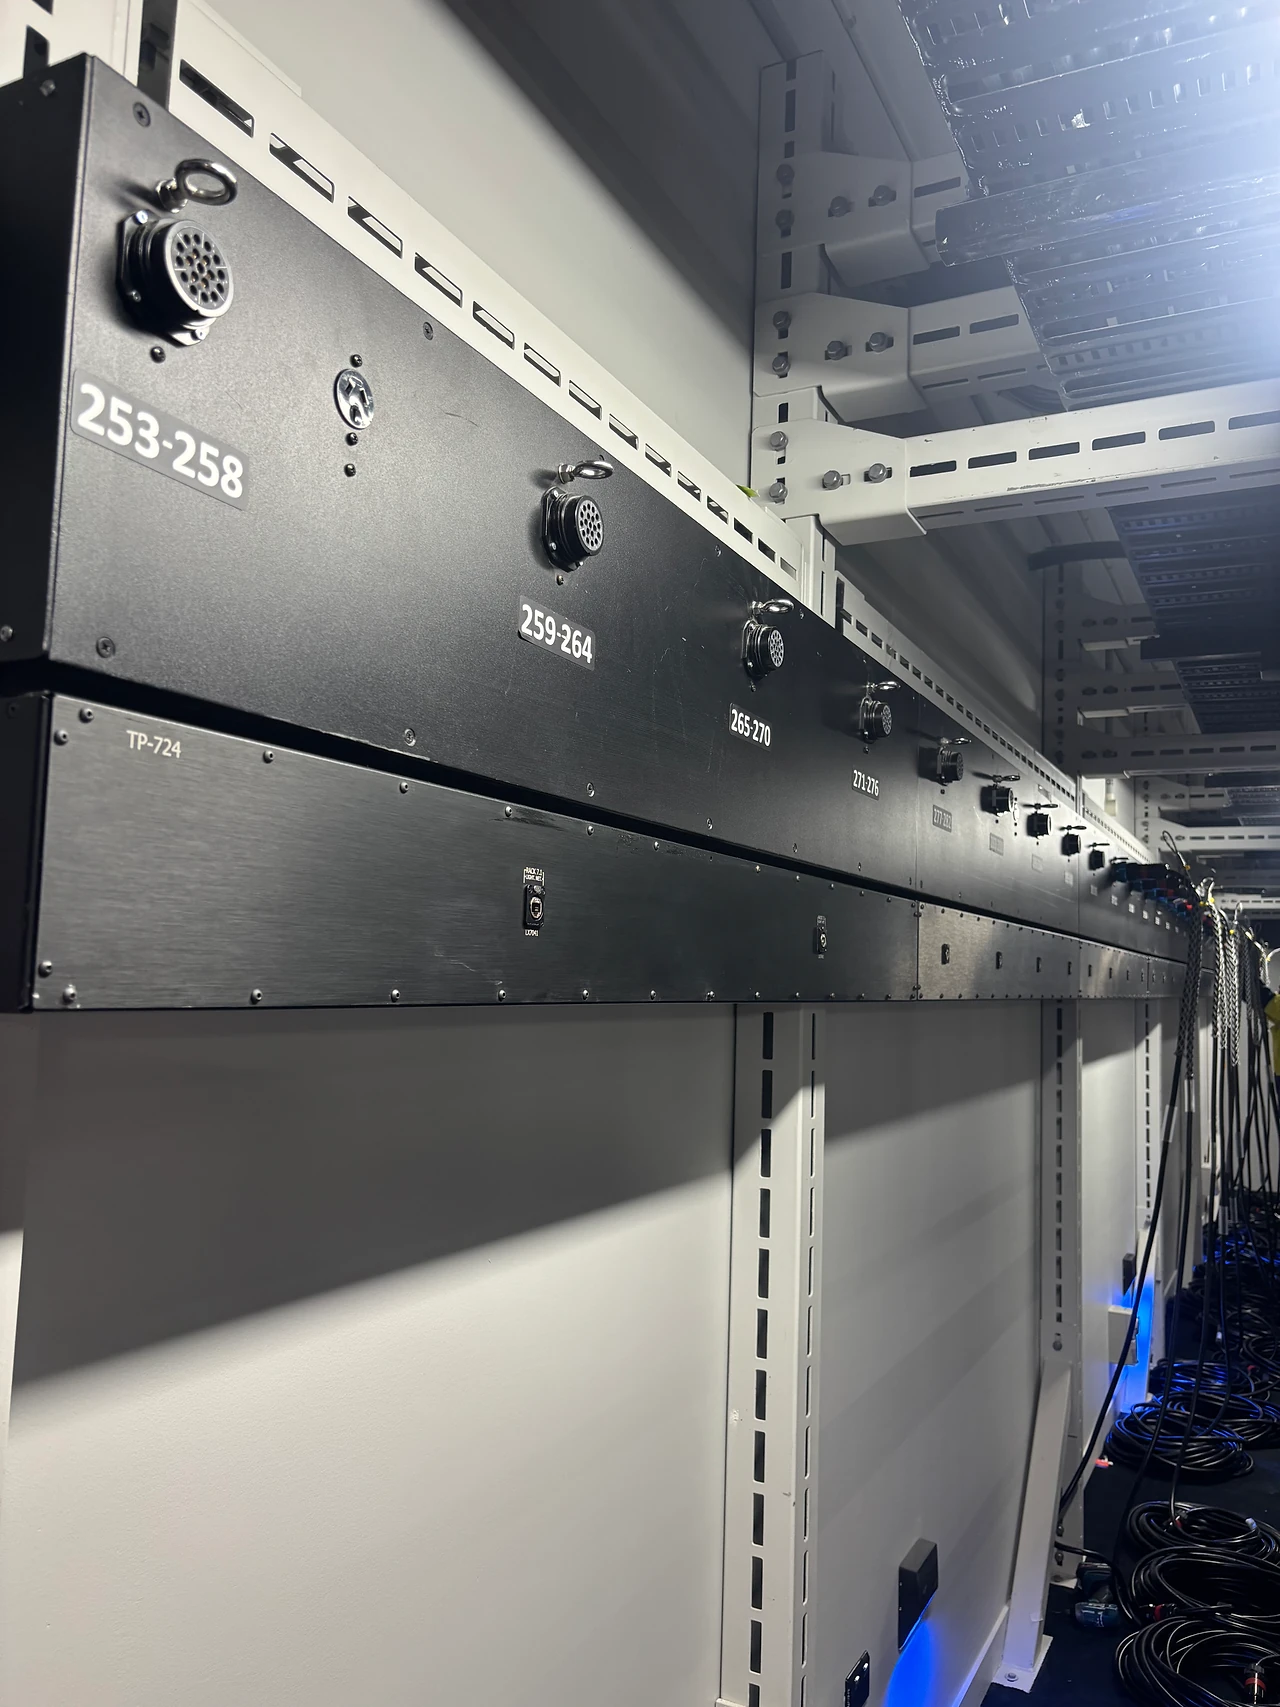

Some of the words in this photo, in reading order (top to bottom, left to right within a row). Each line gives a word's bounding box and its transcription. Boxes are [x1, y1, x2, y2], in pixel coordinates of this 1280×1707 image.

[77, 383, 244, 499] 253-258
[521, 603, 593, 664] 259-264
[126, 729, 182, 759] TP-724
[731, 708, 771, 747] 265-270
[853, 769, 880, 797] 271-276
